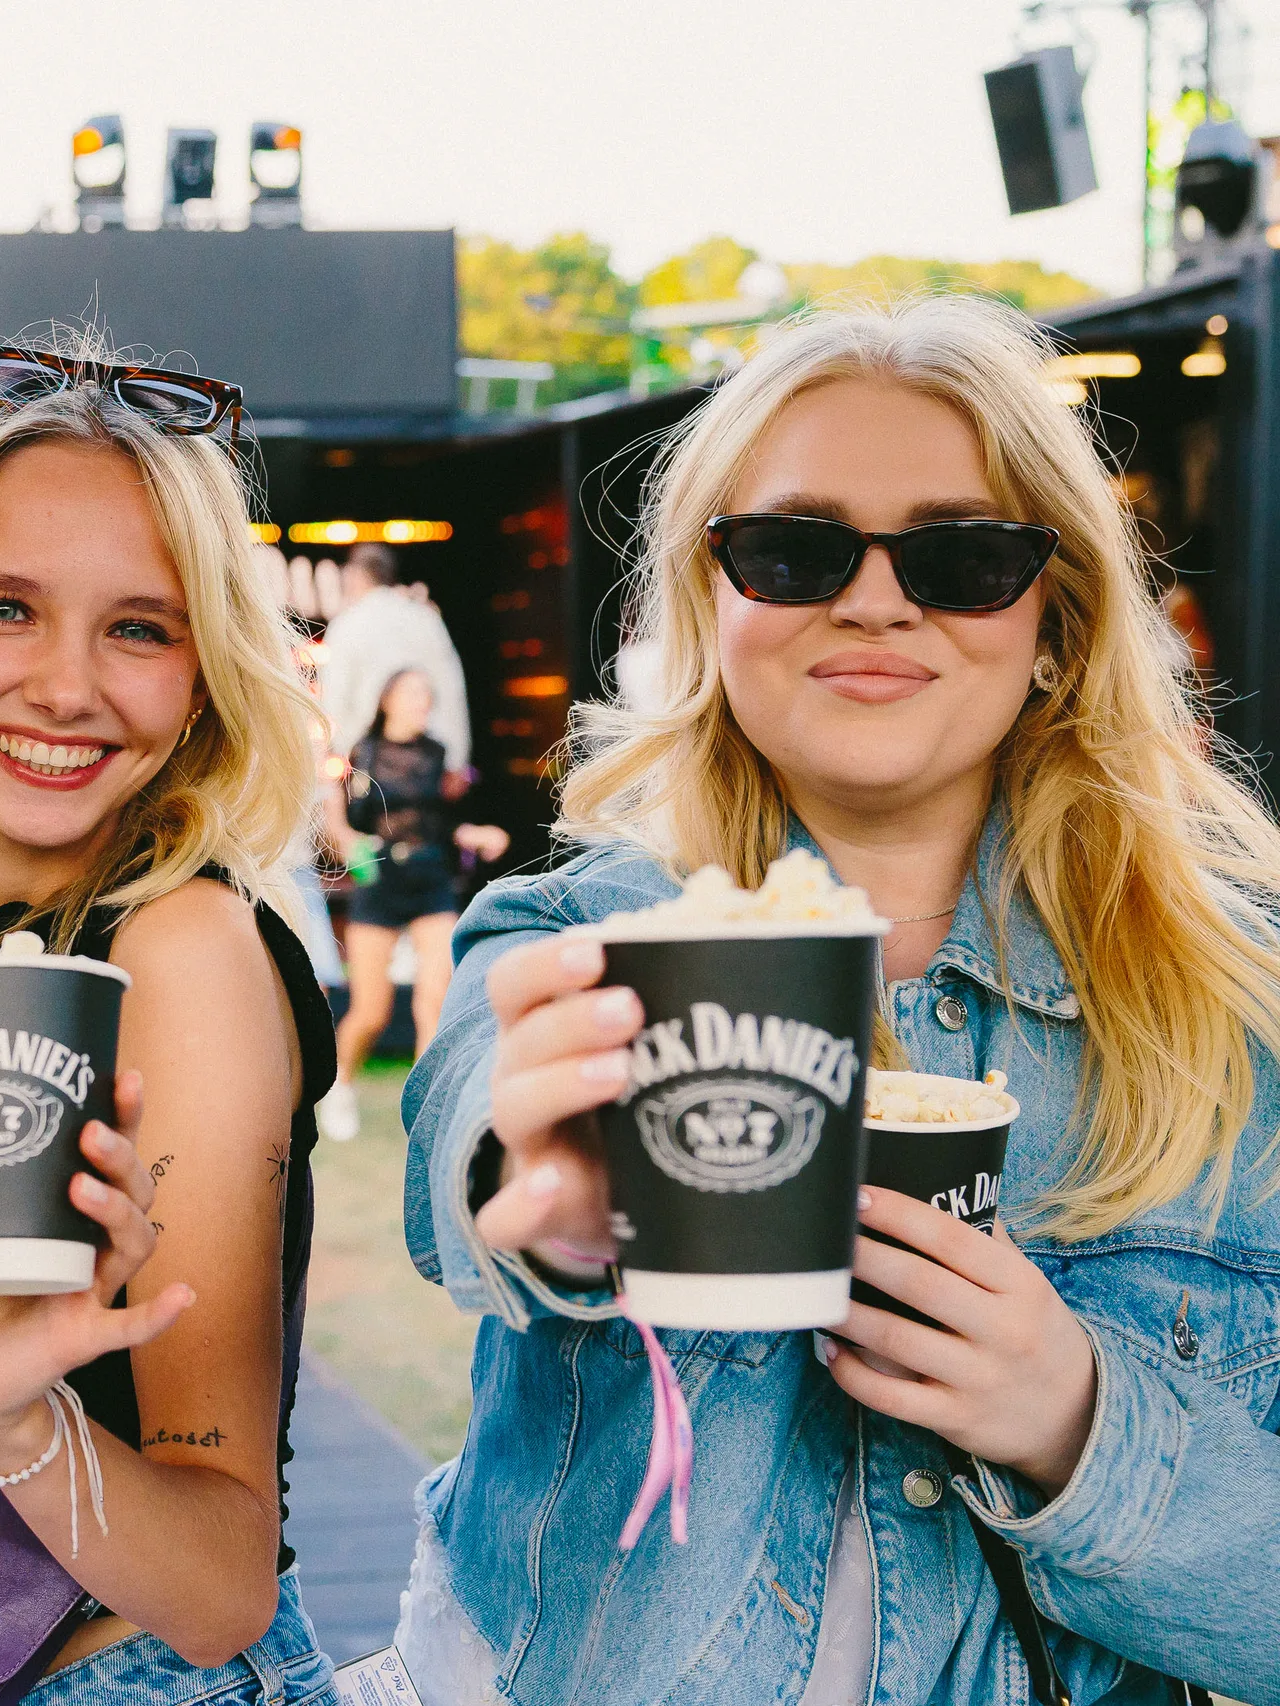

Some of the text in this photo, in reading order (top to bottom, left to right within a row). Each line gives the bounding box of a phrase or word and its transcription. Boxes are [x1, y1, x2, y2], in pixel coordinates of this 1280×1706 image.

[618, 1001, 860, 1107] CK DANIEL'S
[931, 1172, 1003, 1219] CK DA
